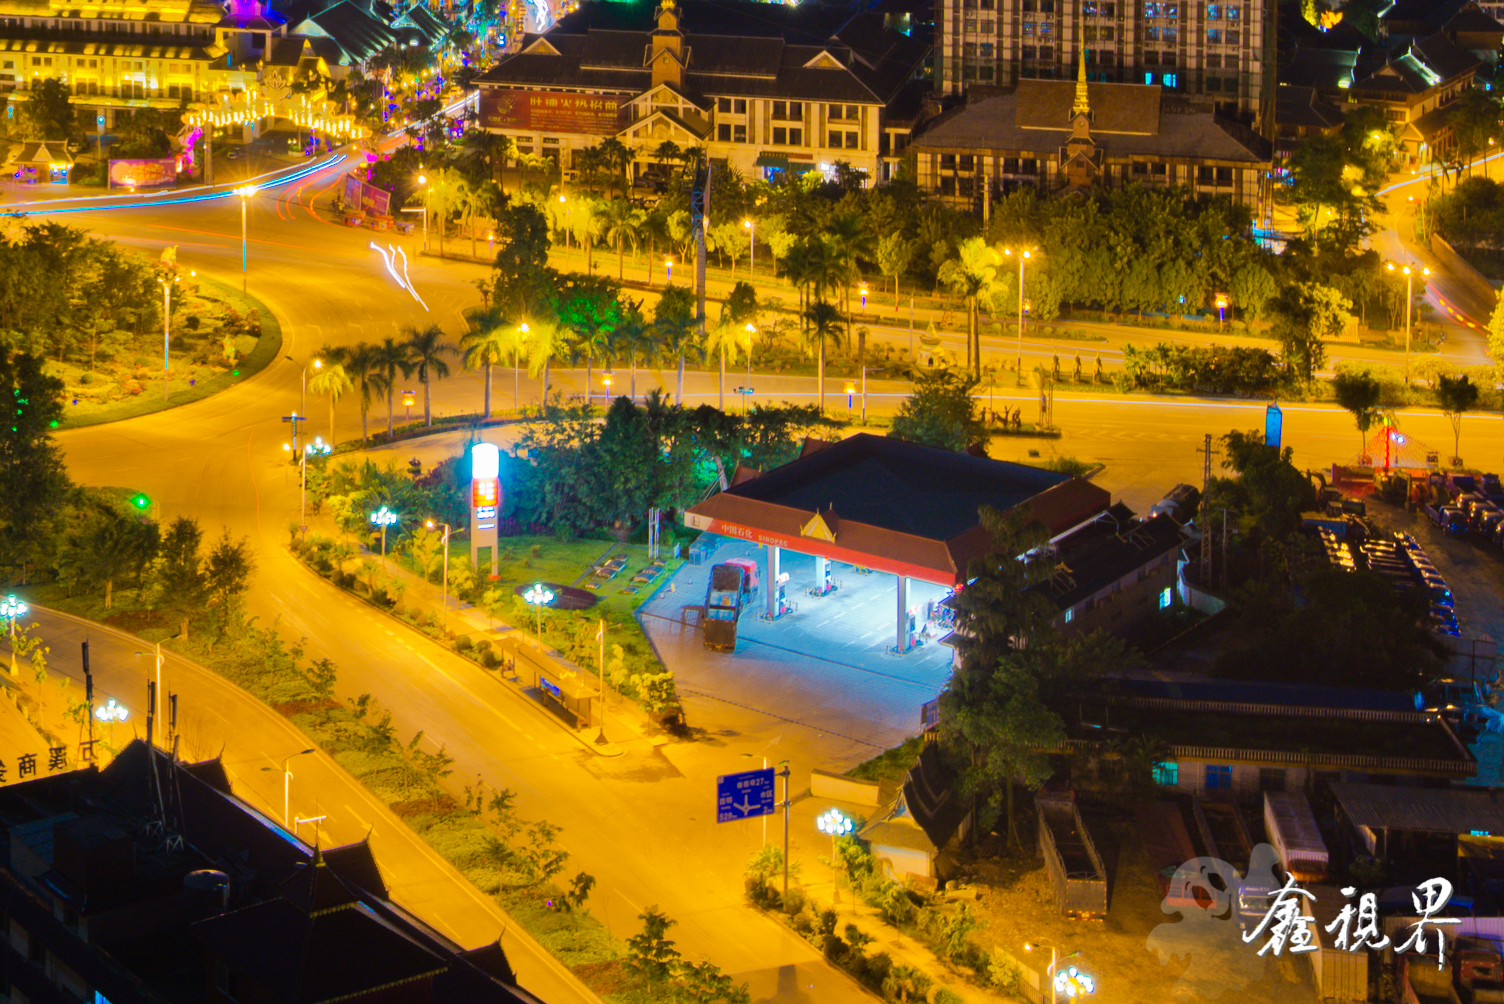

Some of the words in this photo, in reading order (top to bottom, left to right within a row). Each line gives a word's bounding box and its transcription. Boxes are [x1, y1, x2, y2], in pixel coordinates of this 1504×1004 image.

[721, 524, 753, 539] 中国石化
[758, 534, 788, 547] SINOPEC
